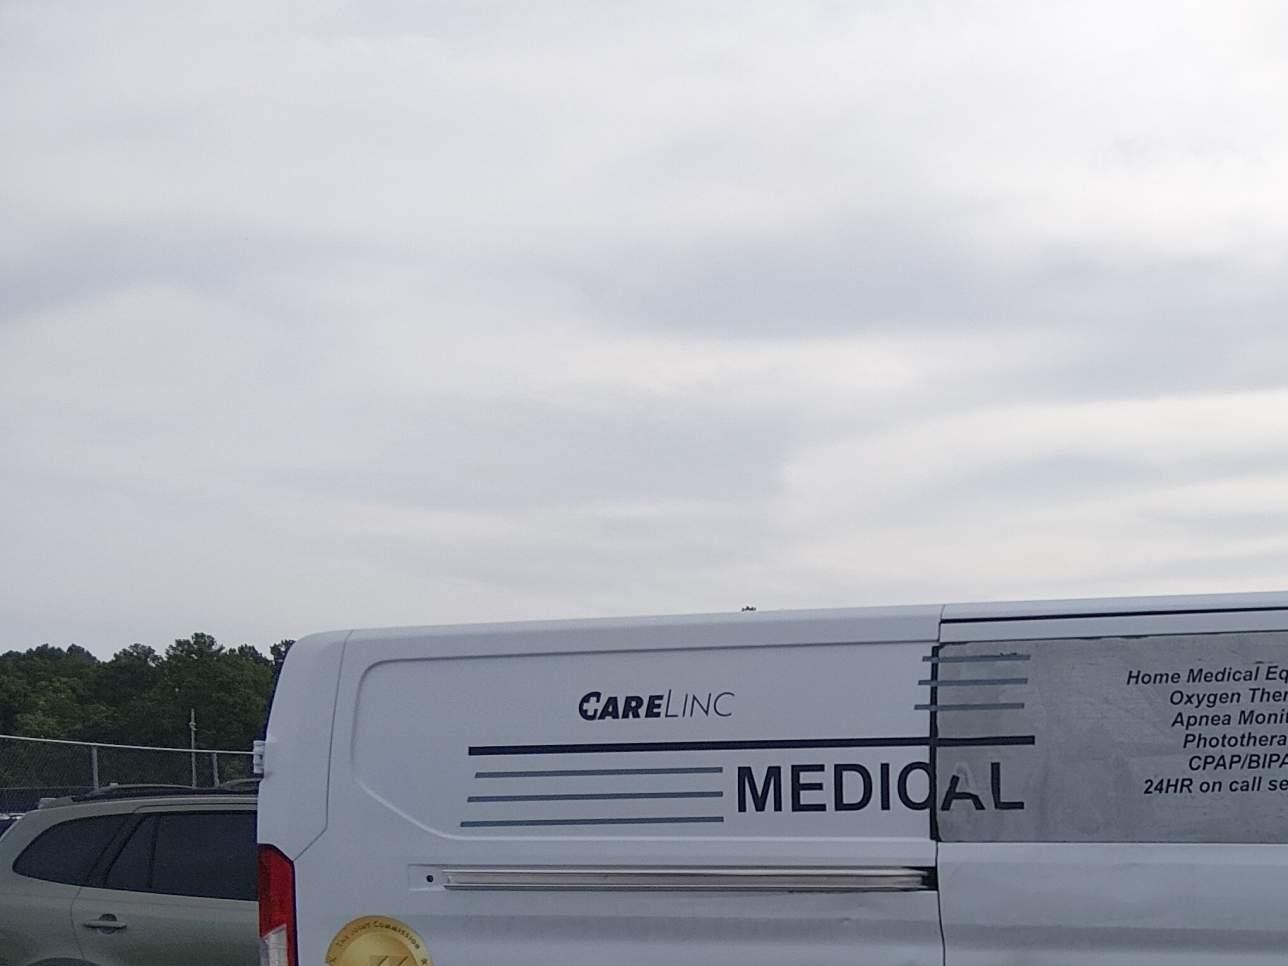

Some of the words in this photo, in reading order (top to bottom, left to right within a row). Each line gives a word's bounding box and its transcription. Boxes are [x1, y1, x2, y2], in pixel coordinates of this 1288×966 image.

[1126, 669, 1181, 686] Home
[1186, 665, 1260, 684] Medical
[1169, 689, 1241, 708] Oxygen
[1171, 711, 1231, 730] Apnea
[737, 761, 1025, 812] MEDICAL
[1144, 778, 1193, 794] 24HR
[1199, 780, 1222, 793] on
[1229, 777, 1262, 792] call
